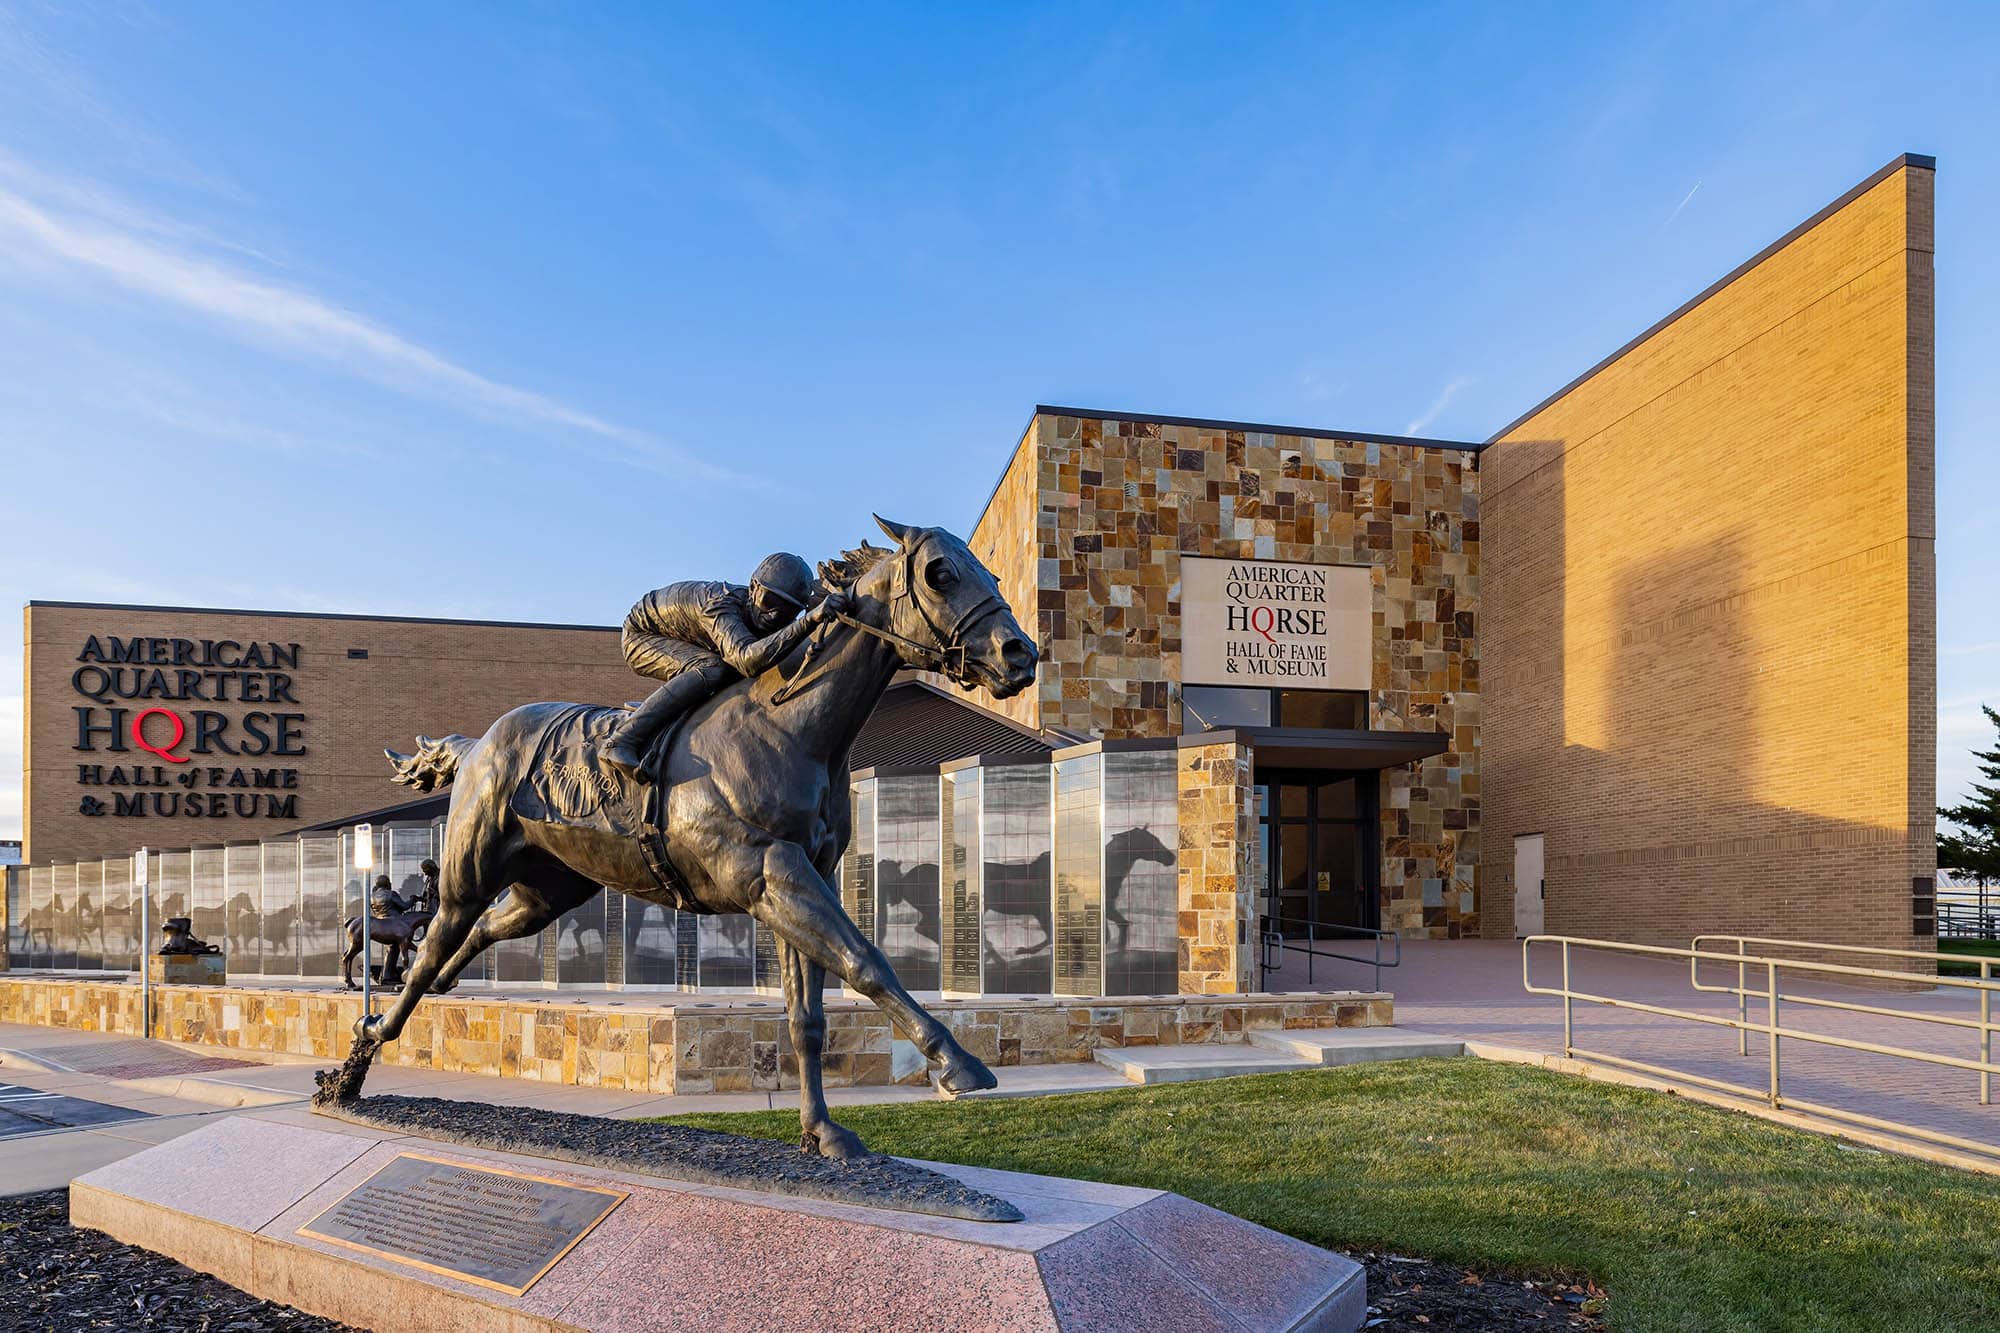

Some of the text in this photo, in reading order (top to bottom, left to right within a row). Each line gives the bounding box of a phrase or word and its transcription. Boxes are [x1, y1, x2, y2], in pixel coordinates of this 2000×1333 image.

[1227, 565, 1326, 585] AMERICAN
[1226, 581, 1327, 604] QUARTER
[76, 634, 302, 669] AMERICAN
[1226, 641, 1327, 660] HALL OF FAME
[1226, 658, 1326, 677] & MUSEUM
[72, 665, 300, 704] QUARTER
[76, 764, 298, 789] HALL of FAME
[79, 791, 298, 818] & MUSEUM
